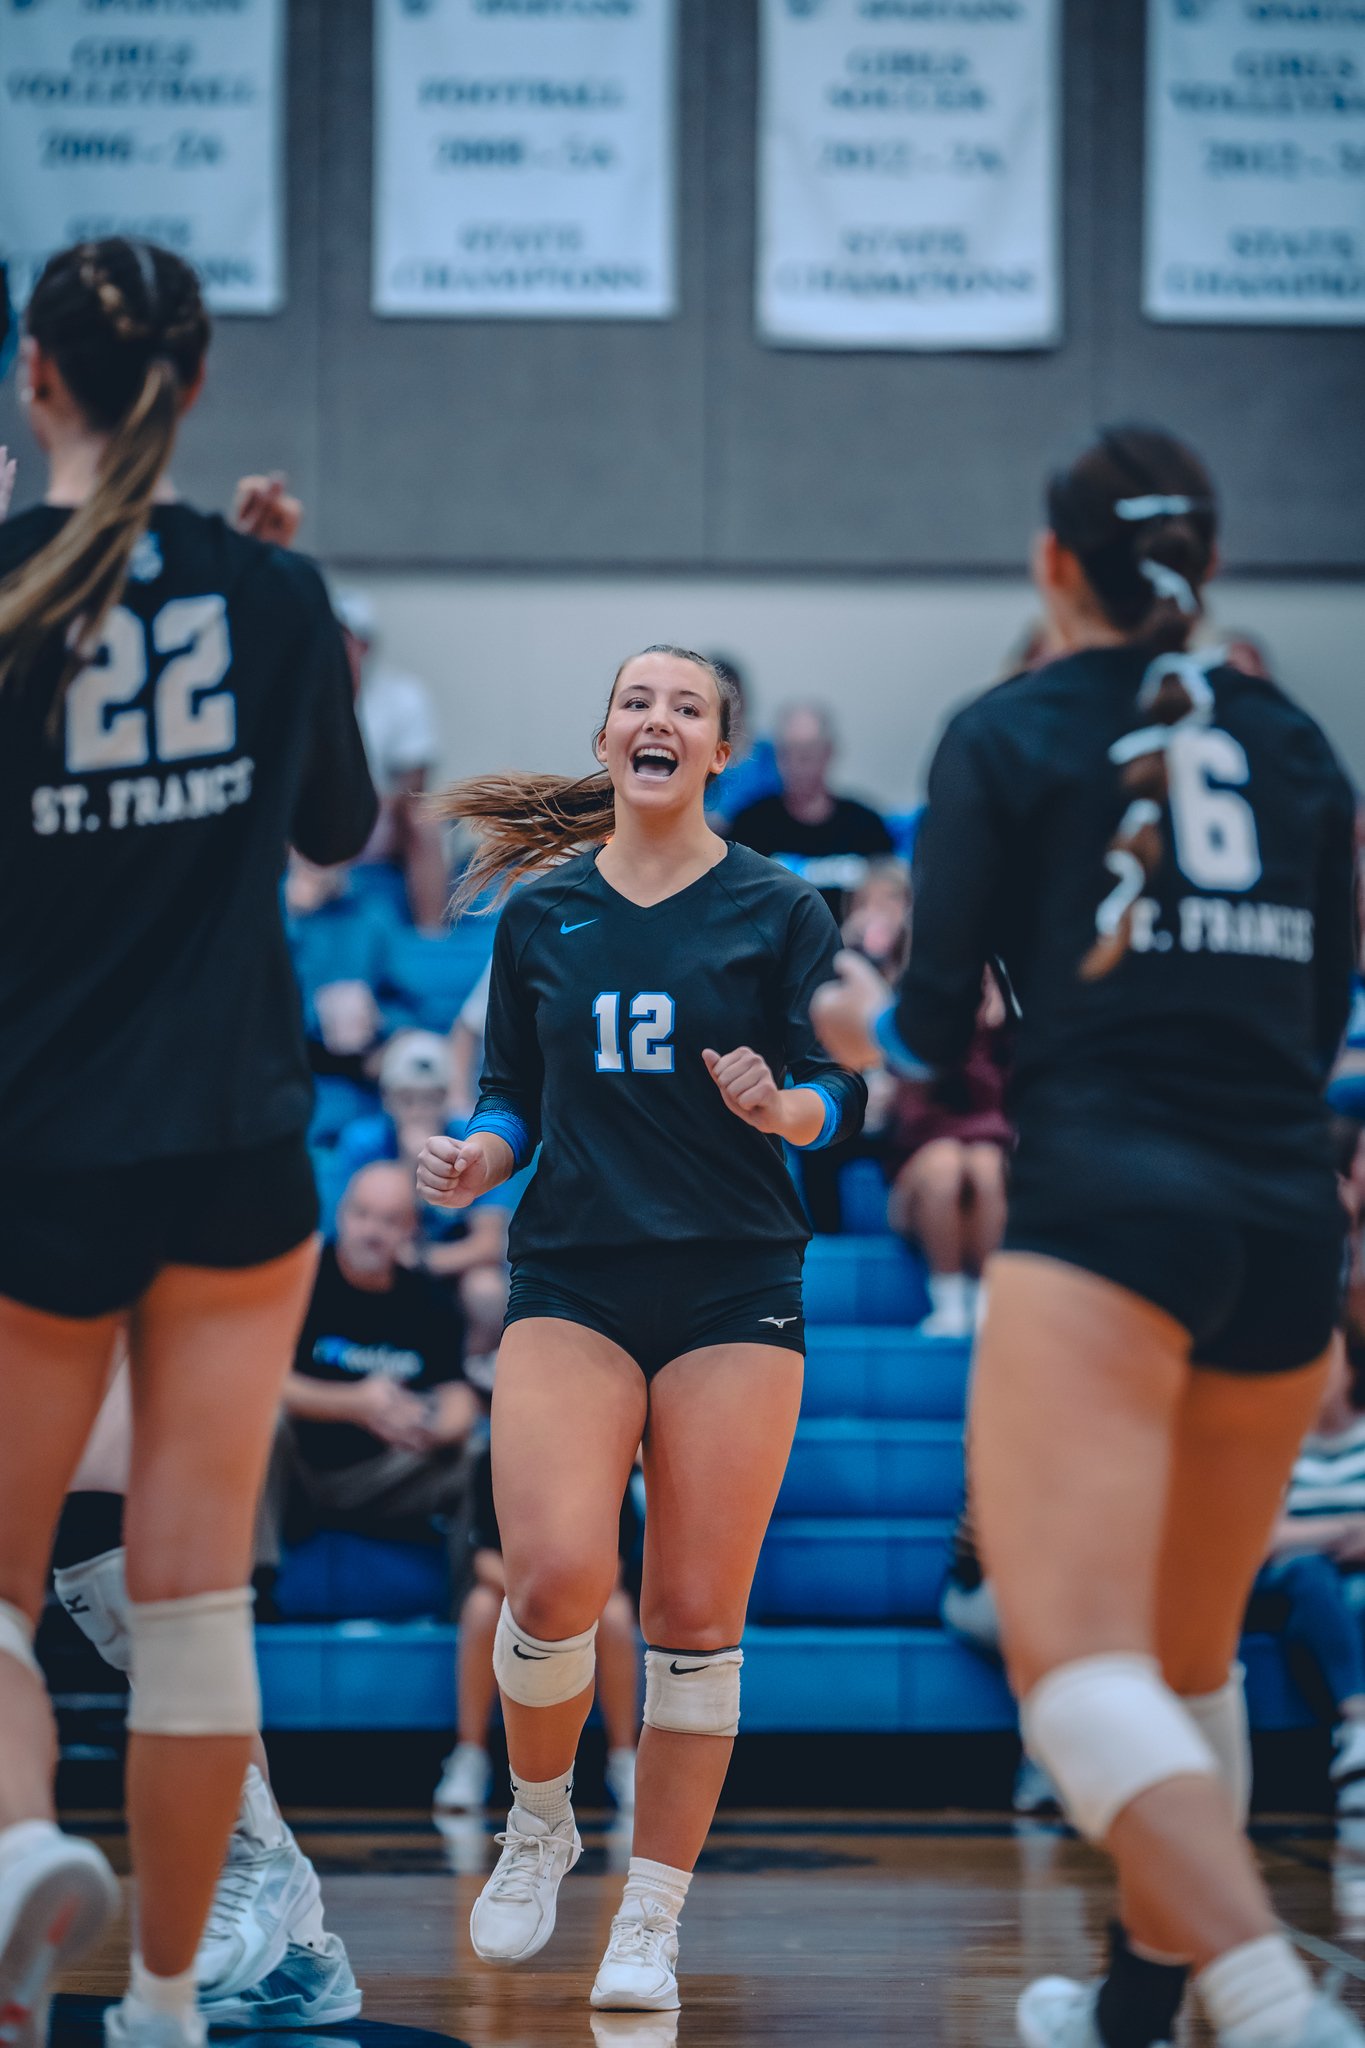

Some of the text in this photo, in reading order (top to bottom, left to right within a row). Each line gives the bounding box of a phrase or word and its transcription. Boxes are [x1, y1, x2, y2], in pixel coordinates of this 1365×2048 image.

[64, 593, 236, 775] 22
[31, 784, 100, 835] ST.
[1166, 726, 1262, 894] 6
[592, 991, 675, 1073] 12
